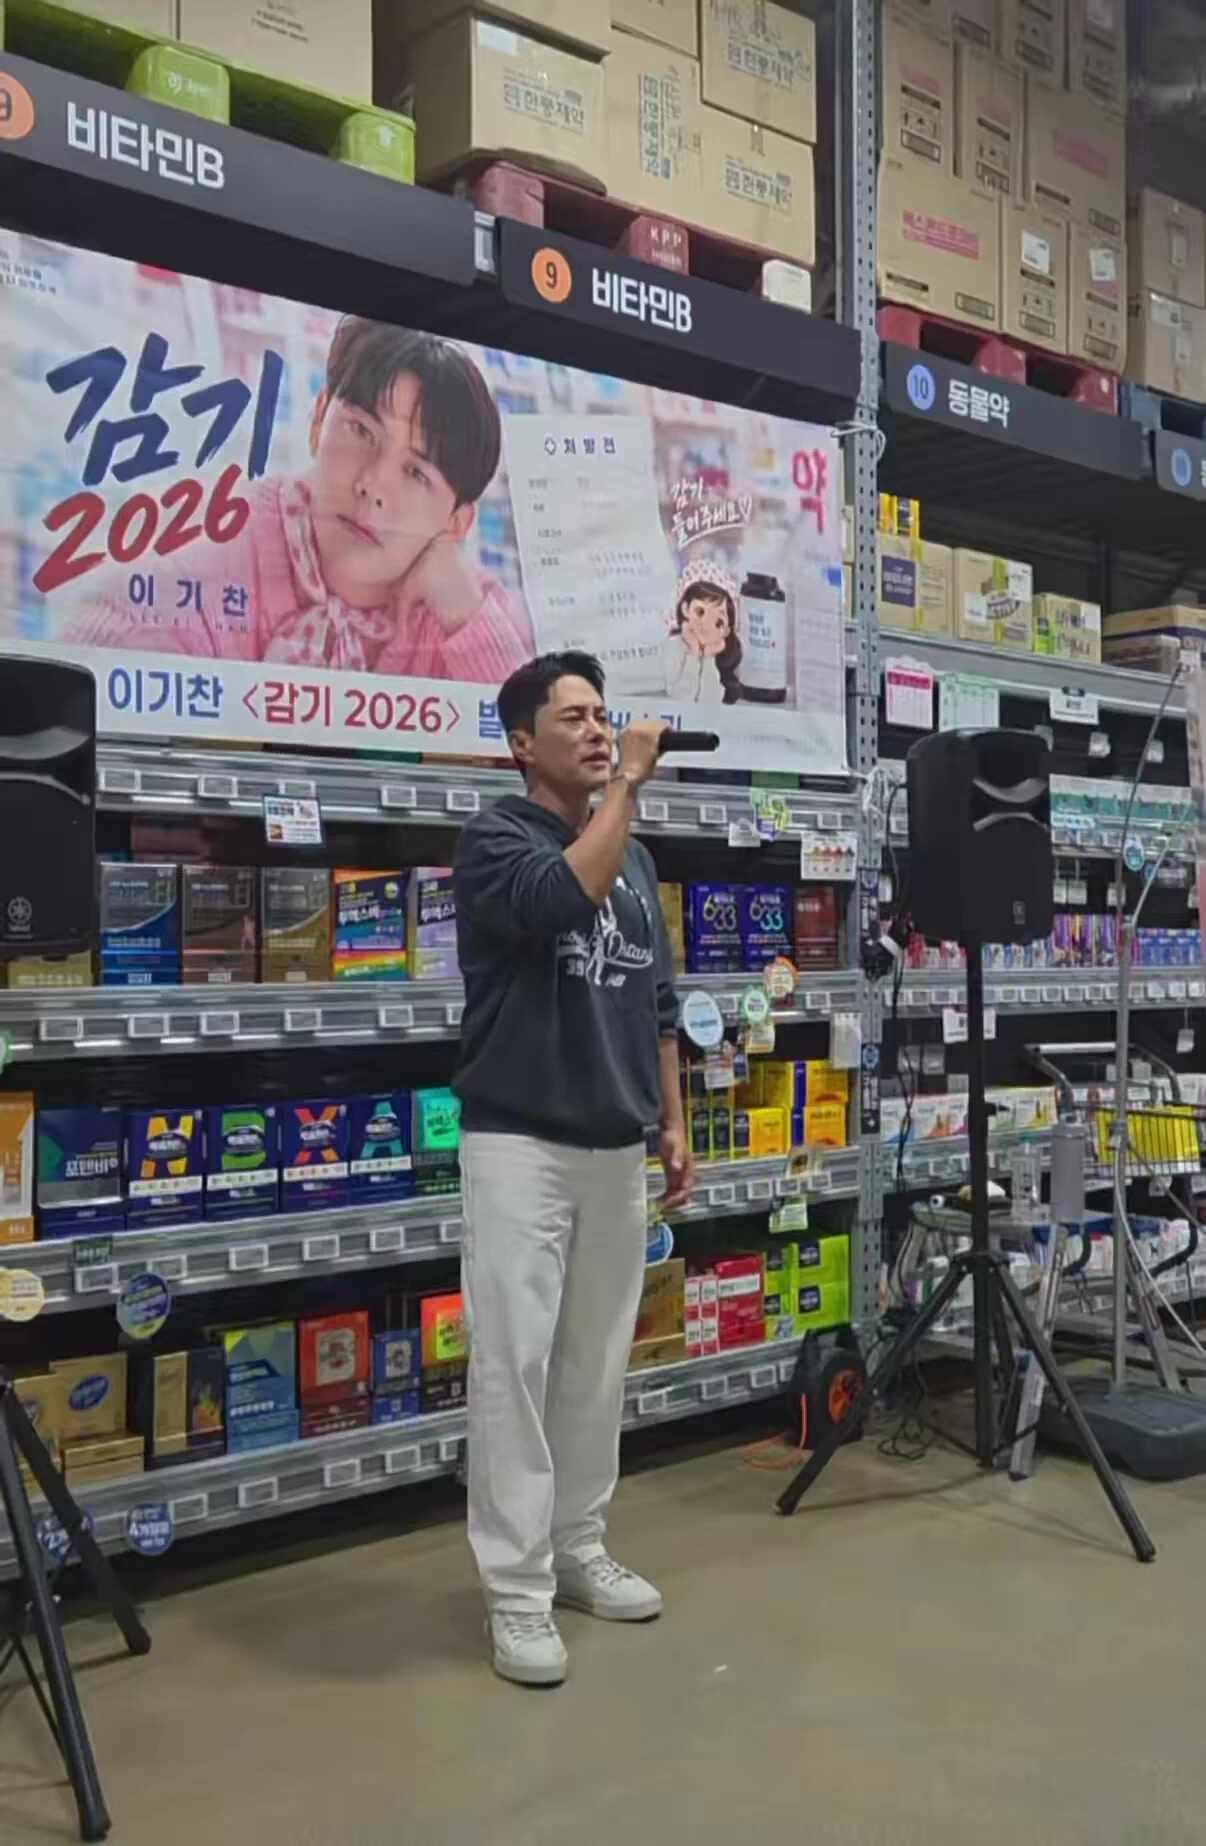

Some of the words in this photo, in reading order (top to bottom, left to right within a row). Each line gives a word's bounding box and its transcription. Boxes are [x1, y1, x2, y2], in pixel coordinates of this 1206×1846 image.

[67, 101, 225, 189] 비타민B
[546, 262, 558, 288] 9
[591, 268, 692, 333] 비타민B
[45, 331, 284, 486] 감기
[913, 374, 929, 400] 10
[948, 378, 1010, 429] 동물약
[32, 463, 250, 593] 2026
[793, 449, 828, 535] 약
[108, 667, 224, 719] 이기찬
